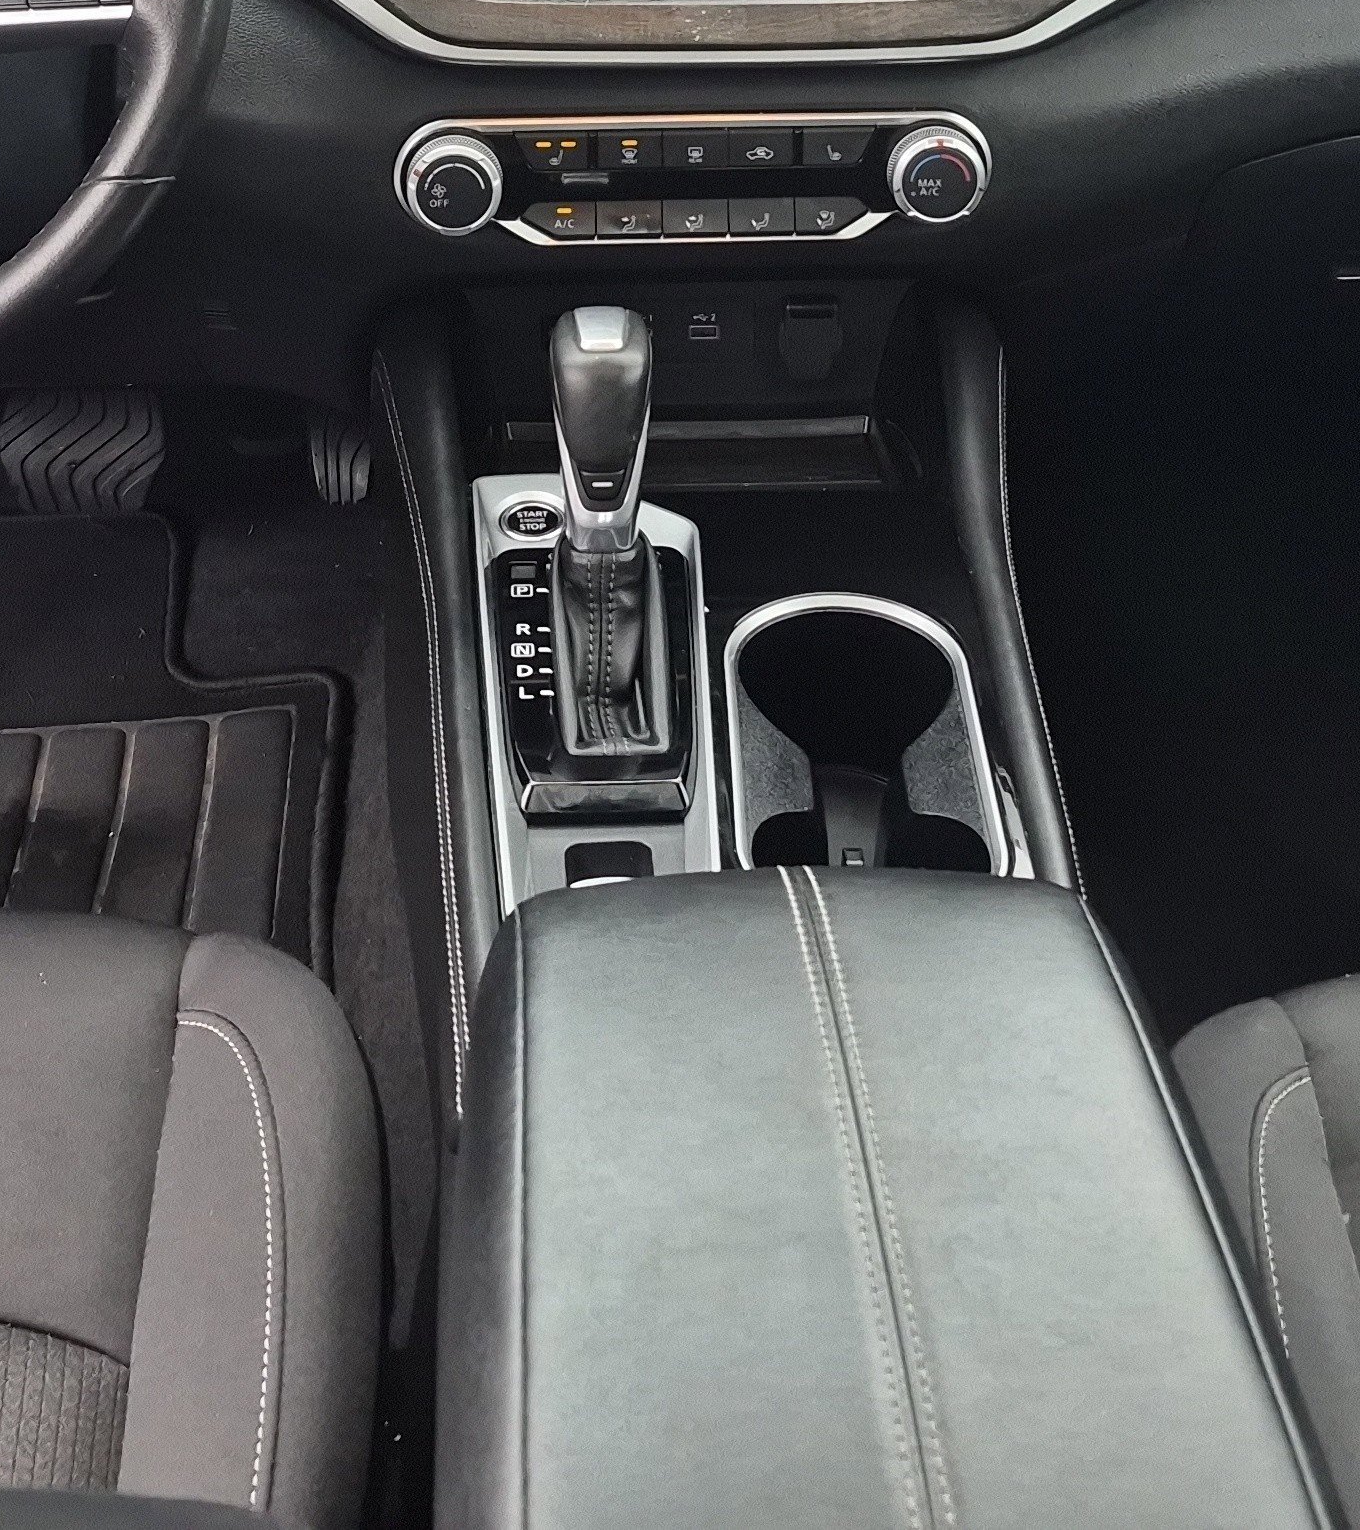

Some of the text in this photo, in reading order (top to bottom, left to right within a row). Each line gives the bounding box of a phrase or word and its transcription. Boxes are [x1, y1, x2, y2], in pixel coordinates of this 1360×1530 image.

[917, 178, 942, 188] MAX
[919, 187, 941, 197] A/C
[429, 198, 450, 208] OFF
[554, 219, 576, 228] A/C
[516, 510, 549, 518] START
[520, 523, 547, 531] STOP
[516, 586, 529, 596] P
[515, 623, 532, 636] R
[515, 645, 530, 656] N
[516, 664, 534, 678] D
[518, 686, 535, 700] L
